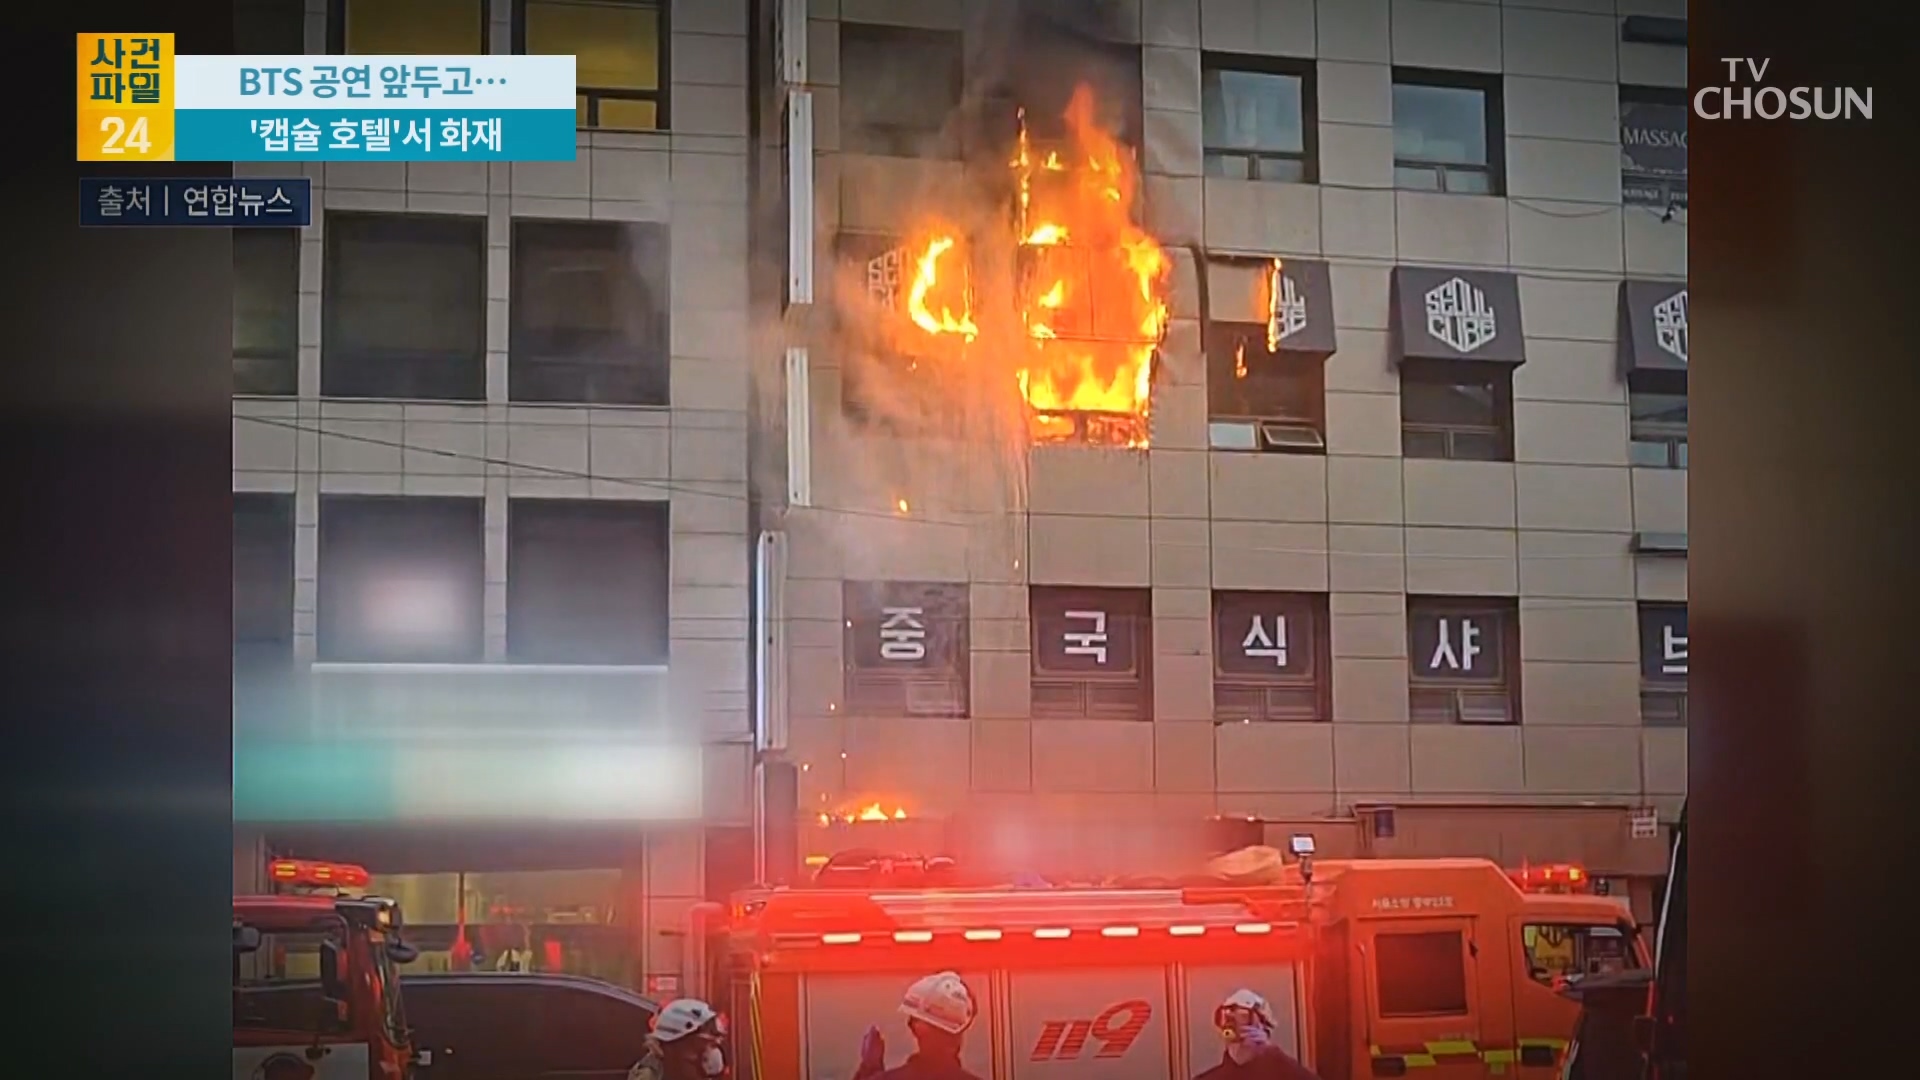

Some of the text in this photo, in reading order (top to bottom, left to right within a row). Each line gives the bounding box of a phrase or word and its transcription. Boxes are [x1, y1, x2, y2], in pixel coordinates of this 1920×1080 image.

[1425, 276, 1494, 317] SEOUL
[1427, 313, 1496, 353] CUBE
[879, 606, 926, 661] 중
[1063, 610, 1108, 664] 국
[1242, 614, 1288, 667] 식
[1429, 618, 1481, 671] 샤
[1029, 999, 1152, 1062] 119
